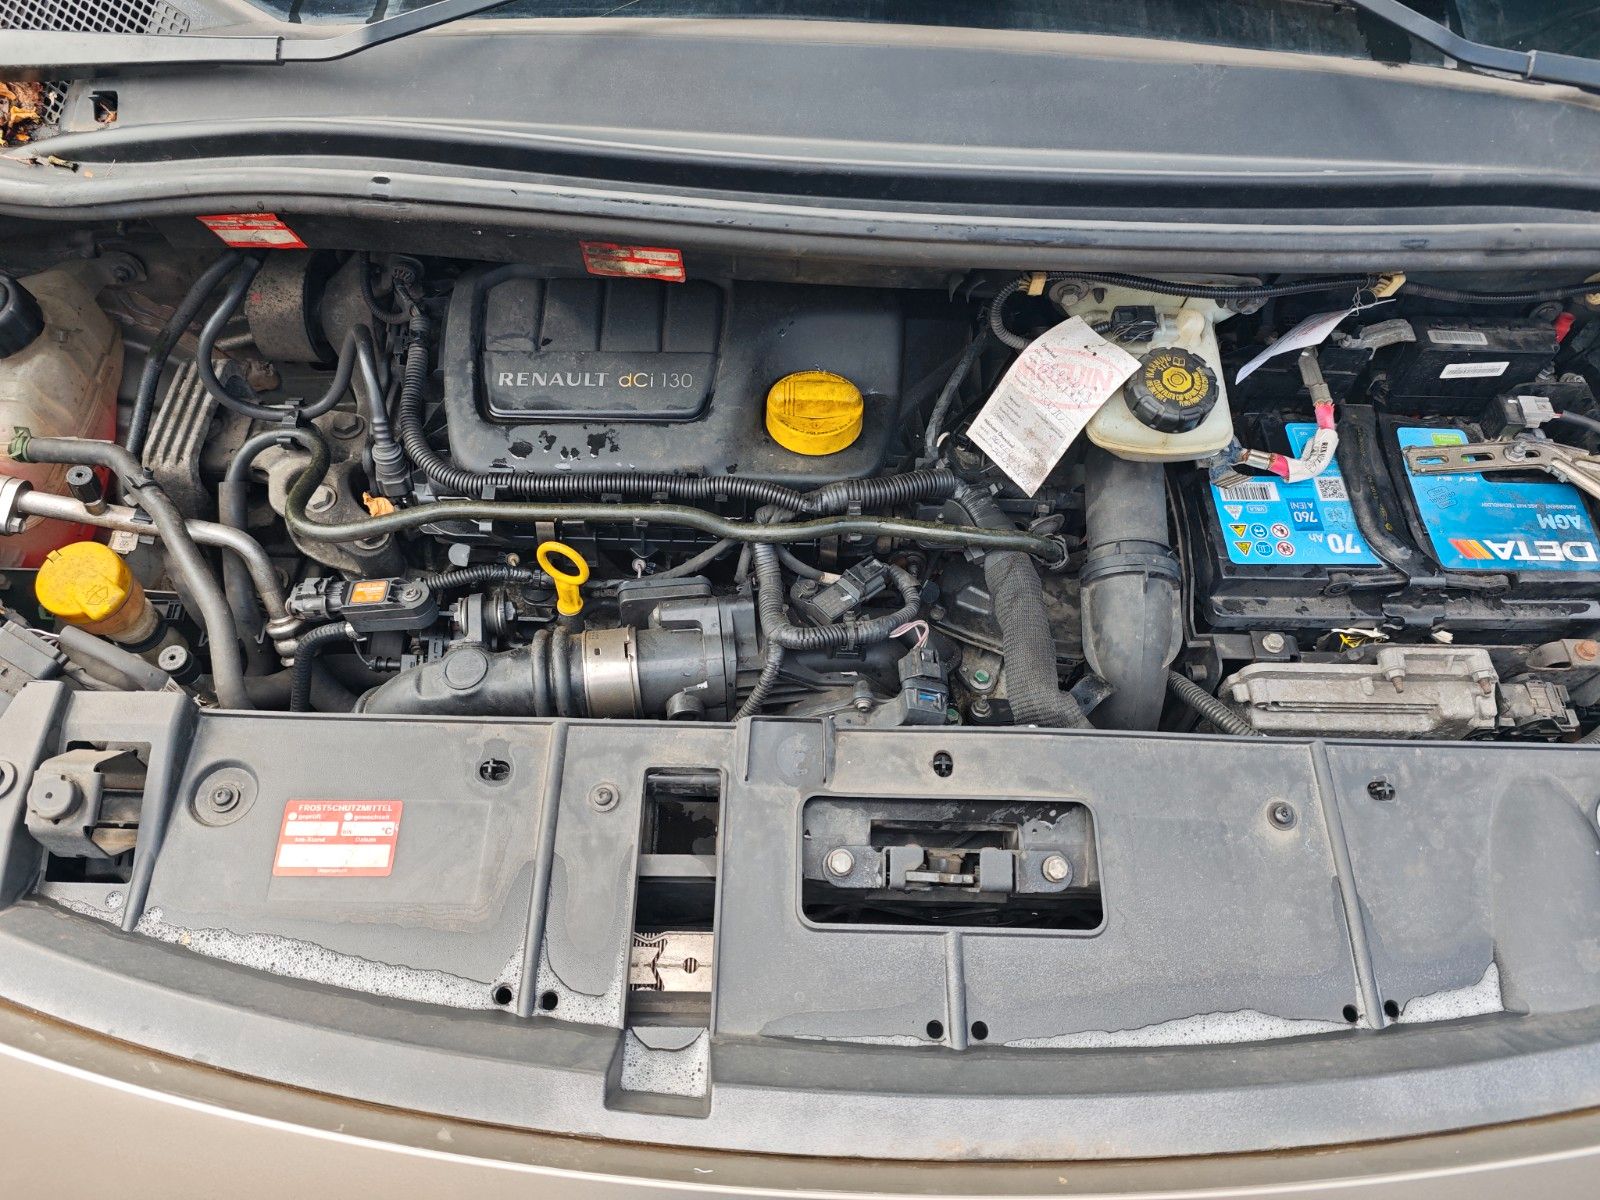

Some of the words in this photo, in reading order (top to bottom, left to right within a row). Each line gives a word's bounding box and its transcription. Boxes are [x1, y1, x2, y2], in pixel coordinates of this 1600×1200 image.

[498, 371, 609, 387] RENAULT
[618, 372, 654, 388] dCi
[662, 373, 693, 388] 130
[1293, 511, 1318, 523] 760
[1536, 513, 1581, 530] AGM
[1308, 532, 1324, 542] Ah
[1327, 533, 1362, 554] 70
[1483, 539, 1599, 562] DETA
[298, 804, 393, 812] FROSTSCHUTZMITTEL
